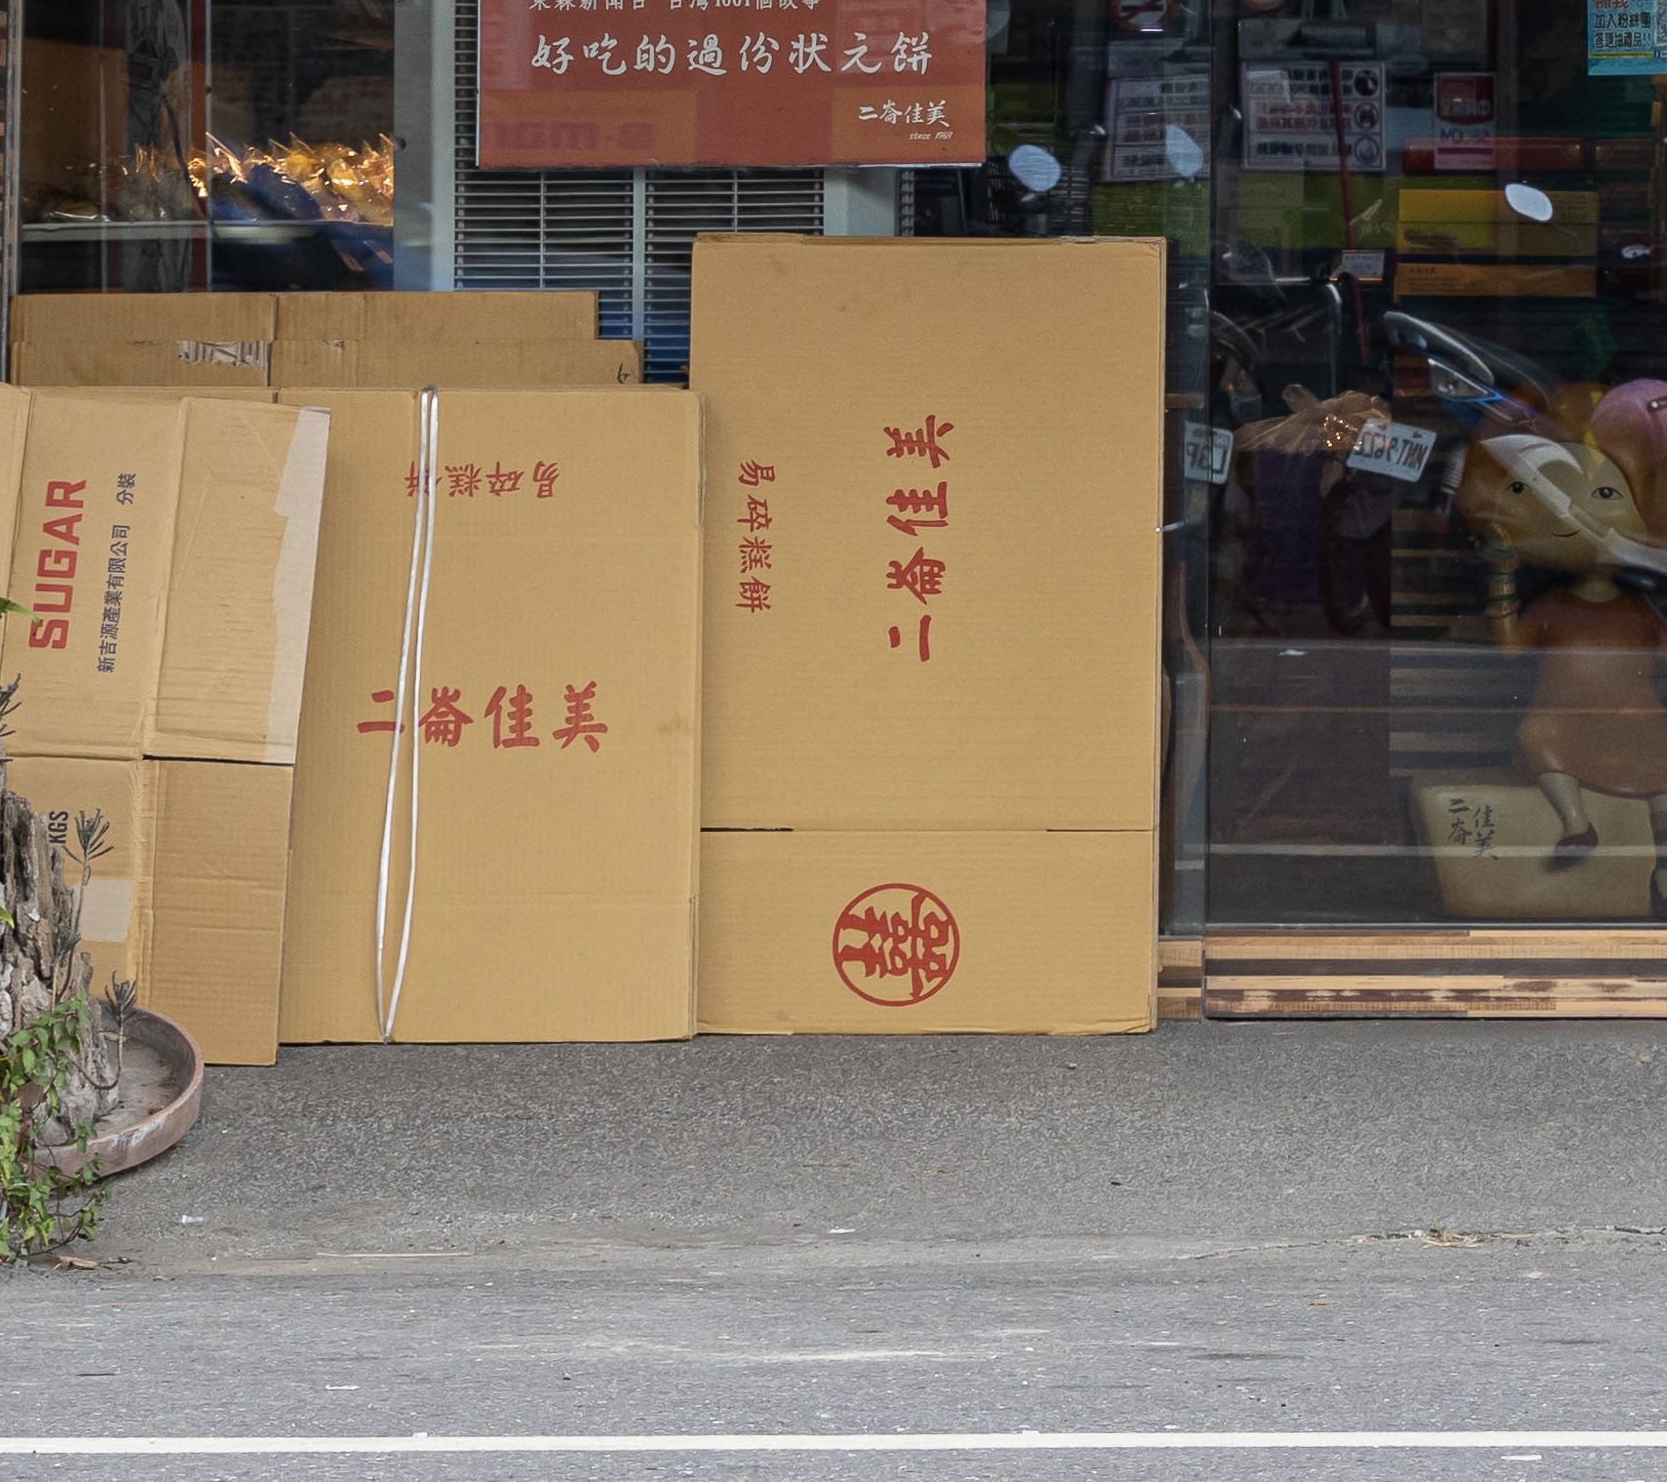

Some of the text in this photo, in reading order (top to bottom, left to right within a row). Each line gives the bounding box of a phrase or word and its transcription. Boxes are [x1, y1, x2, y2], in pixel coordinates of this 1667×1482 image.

[28, 478, 87, 650] SUGAR
[96, 472, 138, 674] 新吉源產業有限公司 分裝
[735, 459, 776, 614] 易碎糕餅
[883, 413, 955, 663] 二崙佳美
[357, 680, 609, 754] 二崙佳美
[48, 809, 69, 845] KGS
